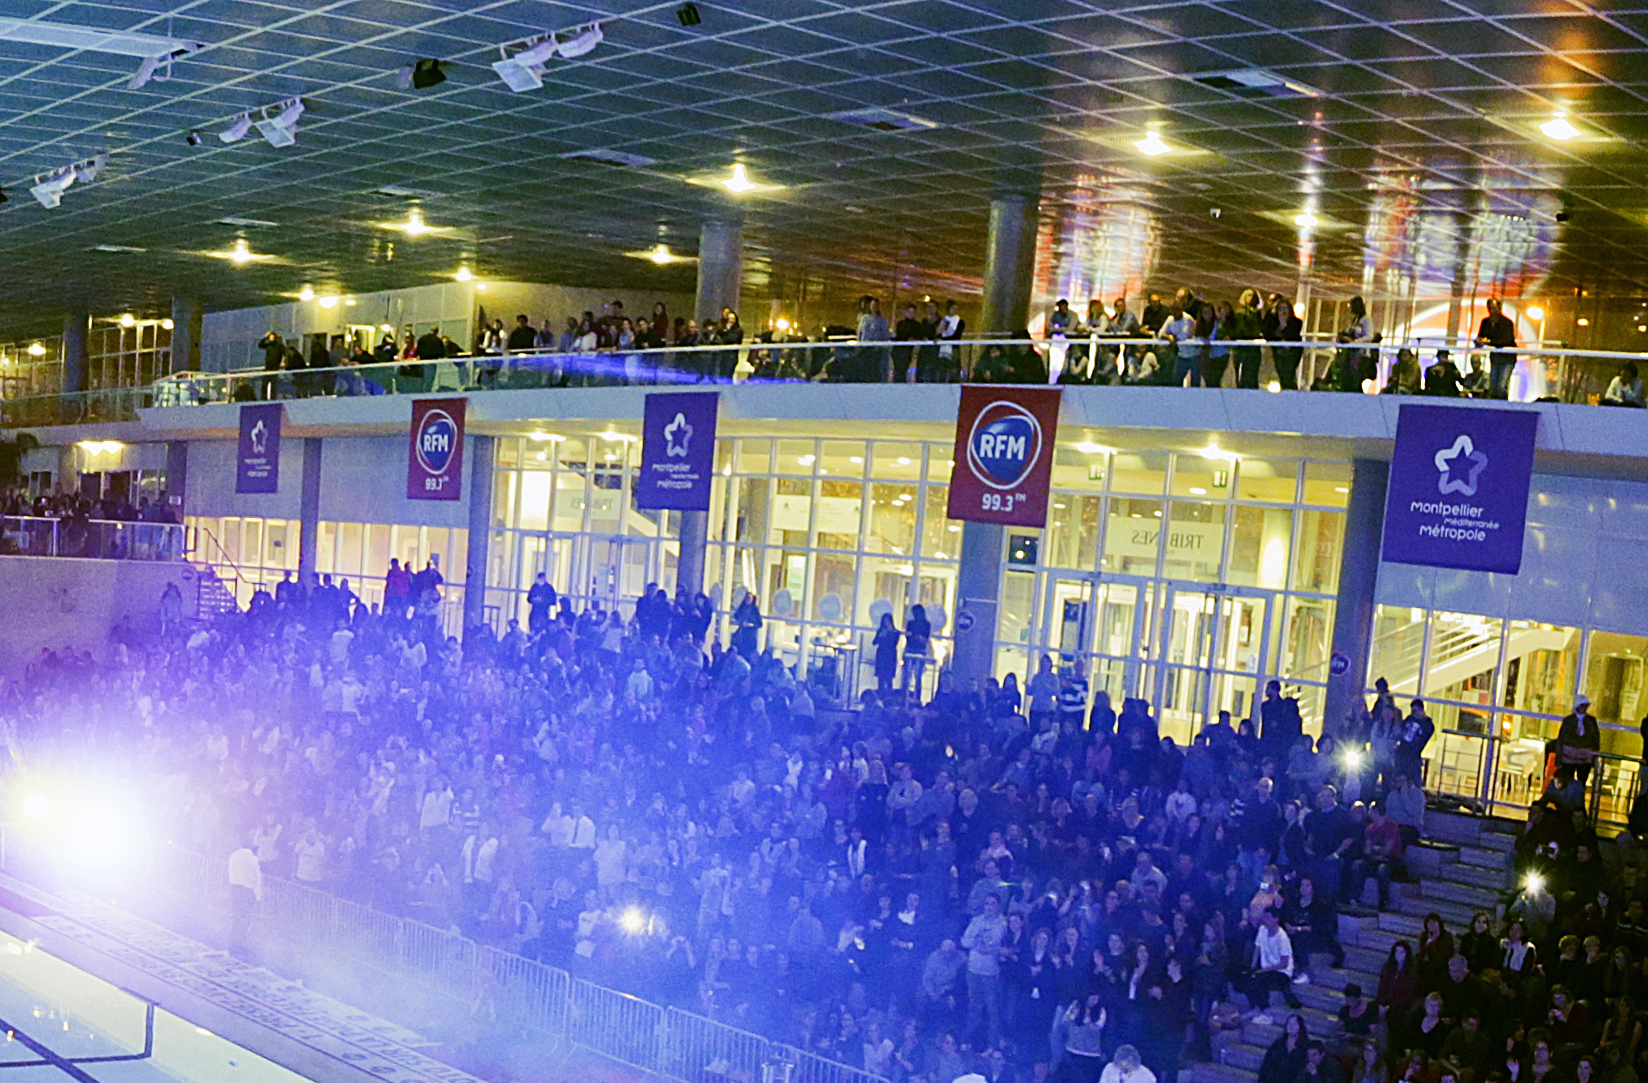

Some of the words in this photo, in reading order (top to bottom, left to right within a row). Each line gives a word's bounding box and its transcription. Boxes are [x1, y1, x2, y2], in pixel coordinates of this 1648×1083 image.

[424, 434, 449, 452] RFM
[979, 434, 1026, 460] RFM
[981, 493, 1014, 512] 99.3
[1410, 501, 1484, 518] Montpellier
[1419, 523, 1486, 541] Métropole
